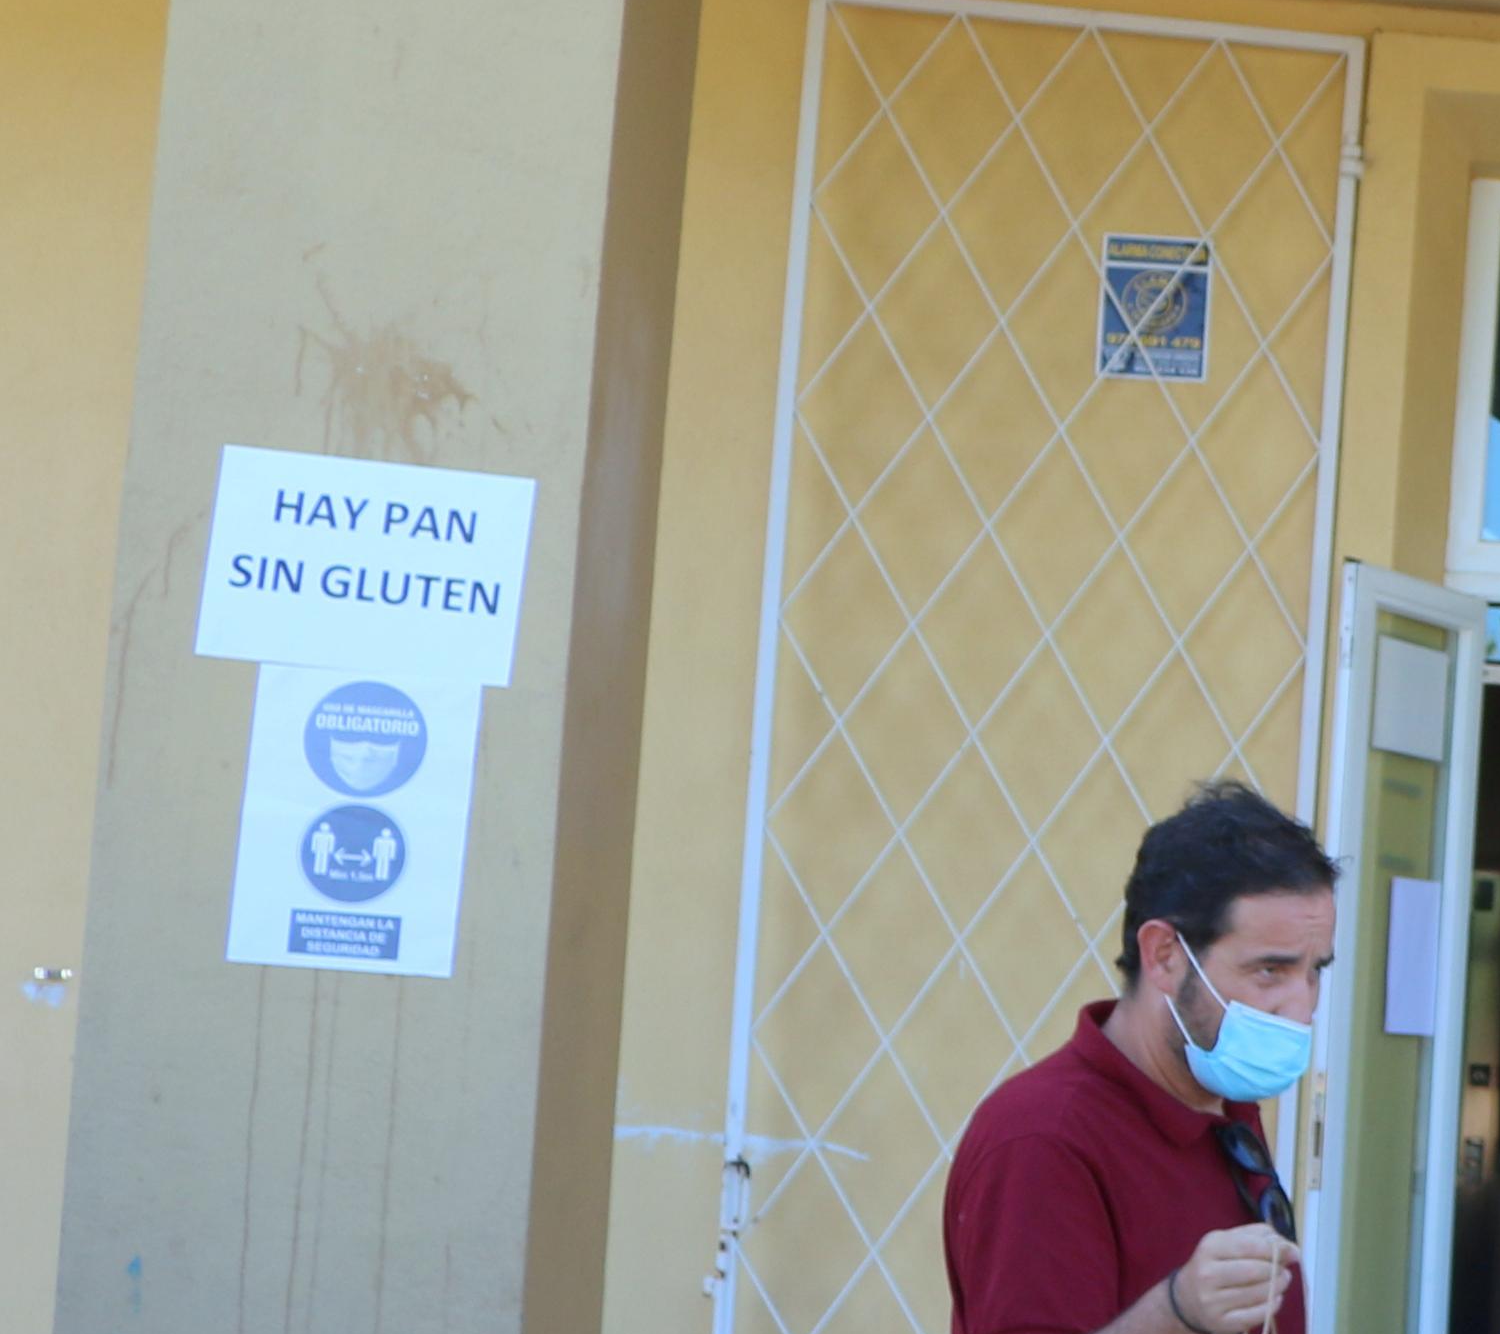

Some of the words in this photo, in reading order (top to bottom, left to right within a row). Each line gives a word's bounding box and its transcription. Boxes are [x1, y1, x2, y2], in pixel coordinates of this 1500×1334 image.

[272, 488, 370, 532] HAY
[382, 502, 478, 545] PAN
[227, 554, 304, 595] SIN
[319, 565, 502, 616] GLUTEN
[315, 713, 419, 737] OBLIGATORIO
